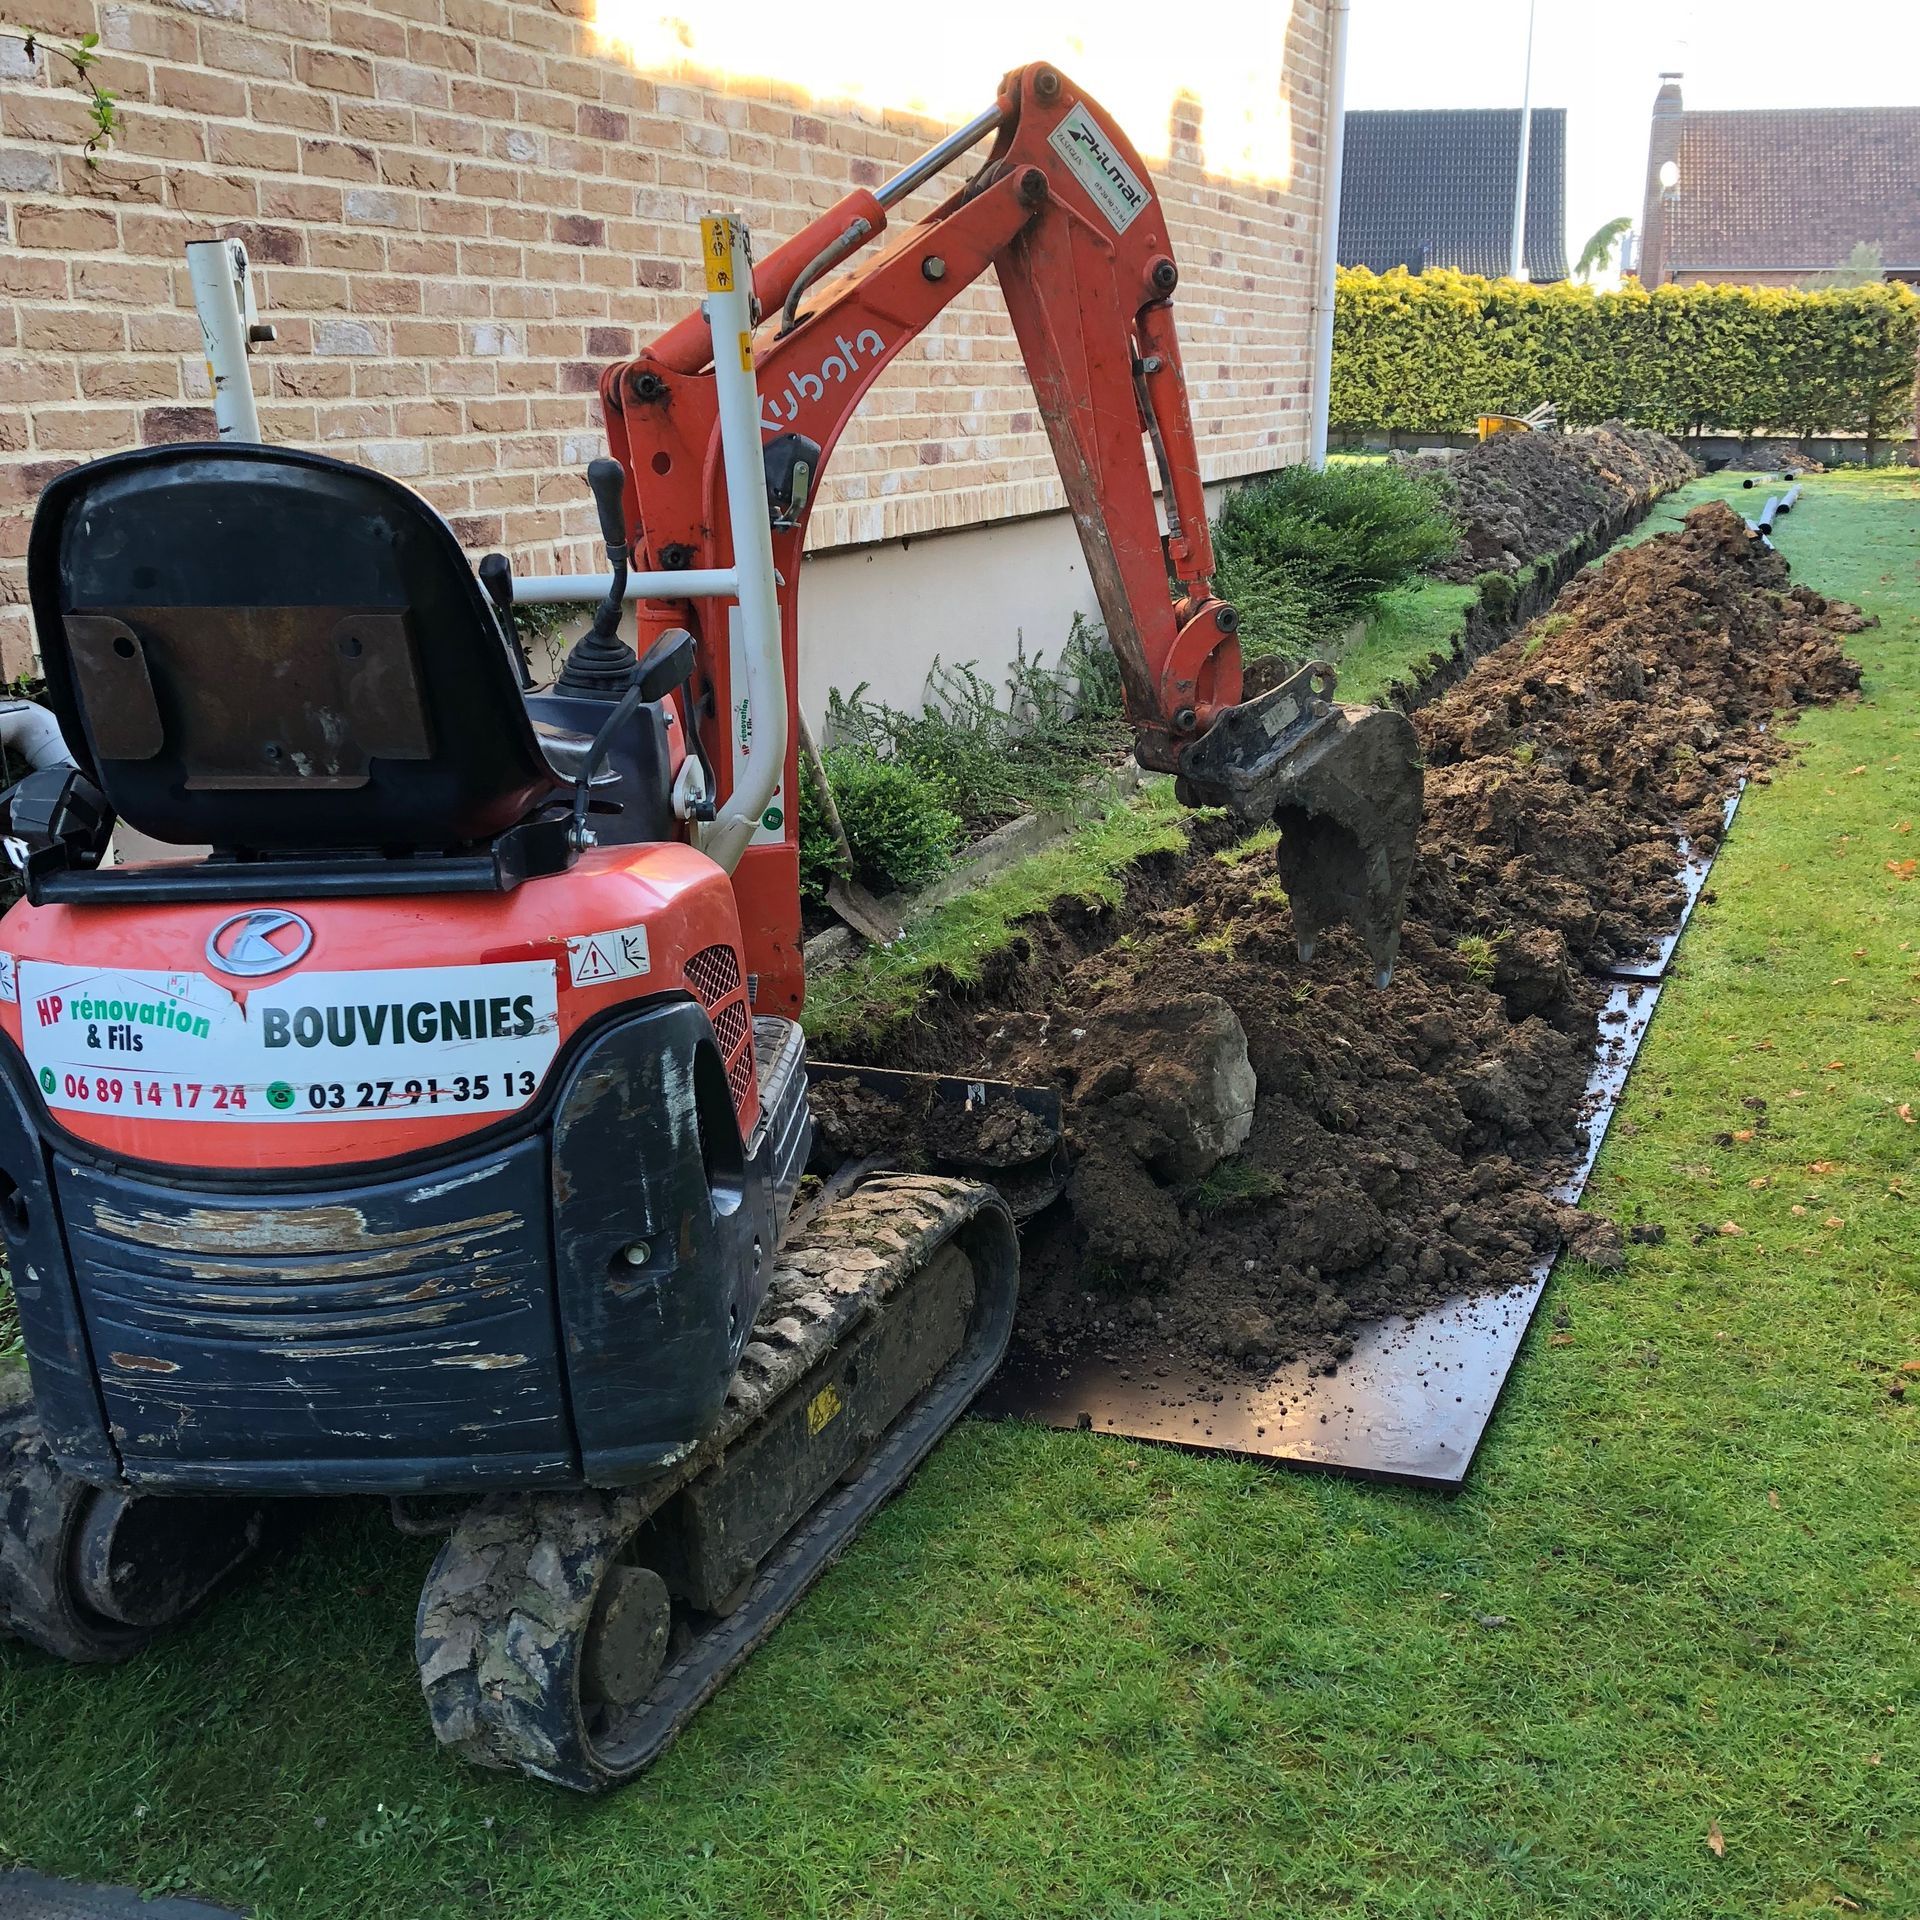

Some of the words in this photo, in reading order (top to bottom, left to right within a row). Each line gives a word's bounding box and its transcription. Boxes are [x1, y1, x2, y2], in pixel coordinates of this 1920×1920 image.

[36, 995, 63, 1028] HP
[70, 992, 212, 1040] rénovation
[262, 995, 535, 1048] BOUVIGNIES
[86, 1023, 102, 1049] &
[107, 1024, 144, 1052] Fils
[64, 1073, 90, 1101] 06
[96, 1077, 124, 1104] 89
[133, 1080, 163, 1107] 14
[172, 1083, 203, 1108] 17
[211, 1083, 247, 1110] 24
[308, 1083, 345, 1109] 03
[355, 1081, 395, 1108] 27
[404, 1079, 439, 1105] 91
[453, 1074, 490, 1102] 35
[503, 1070, 537, 1097] 13
